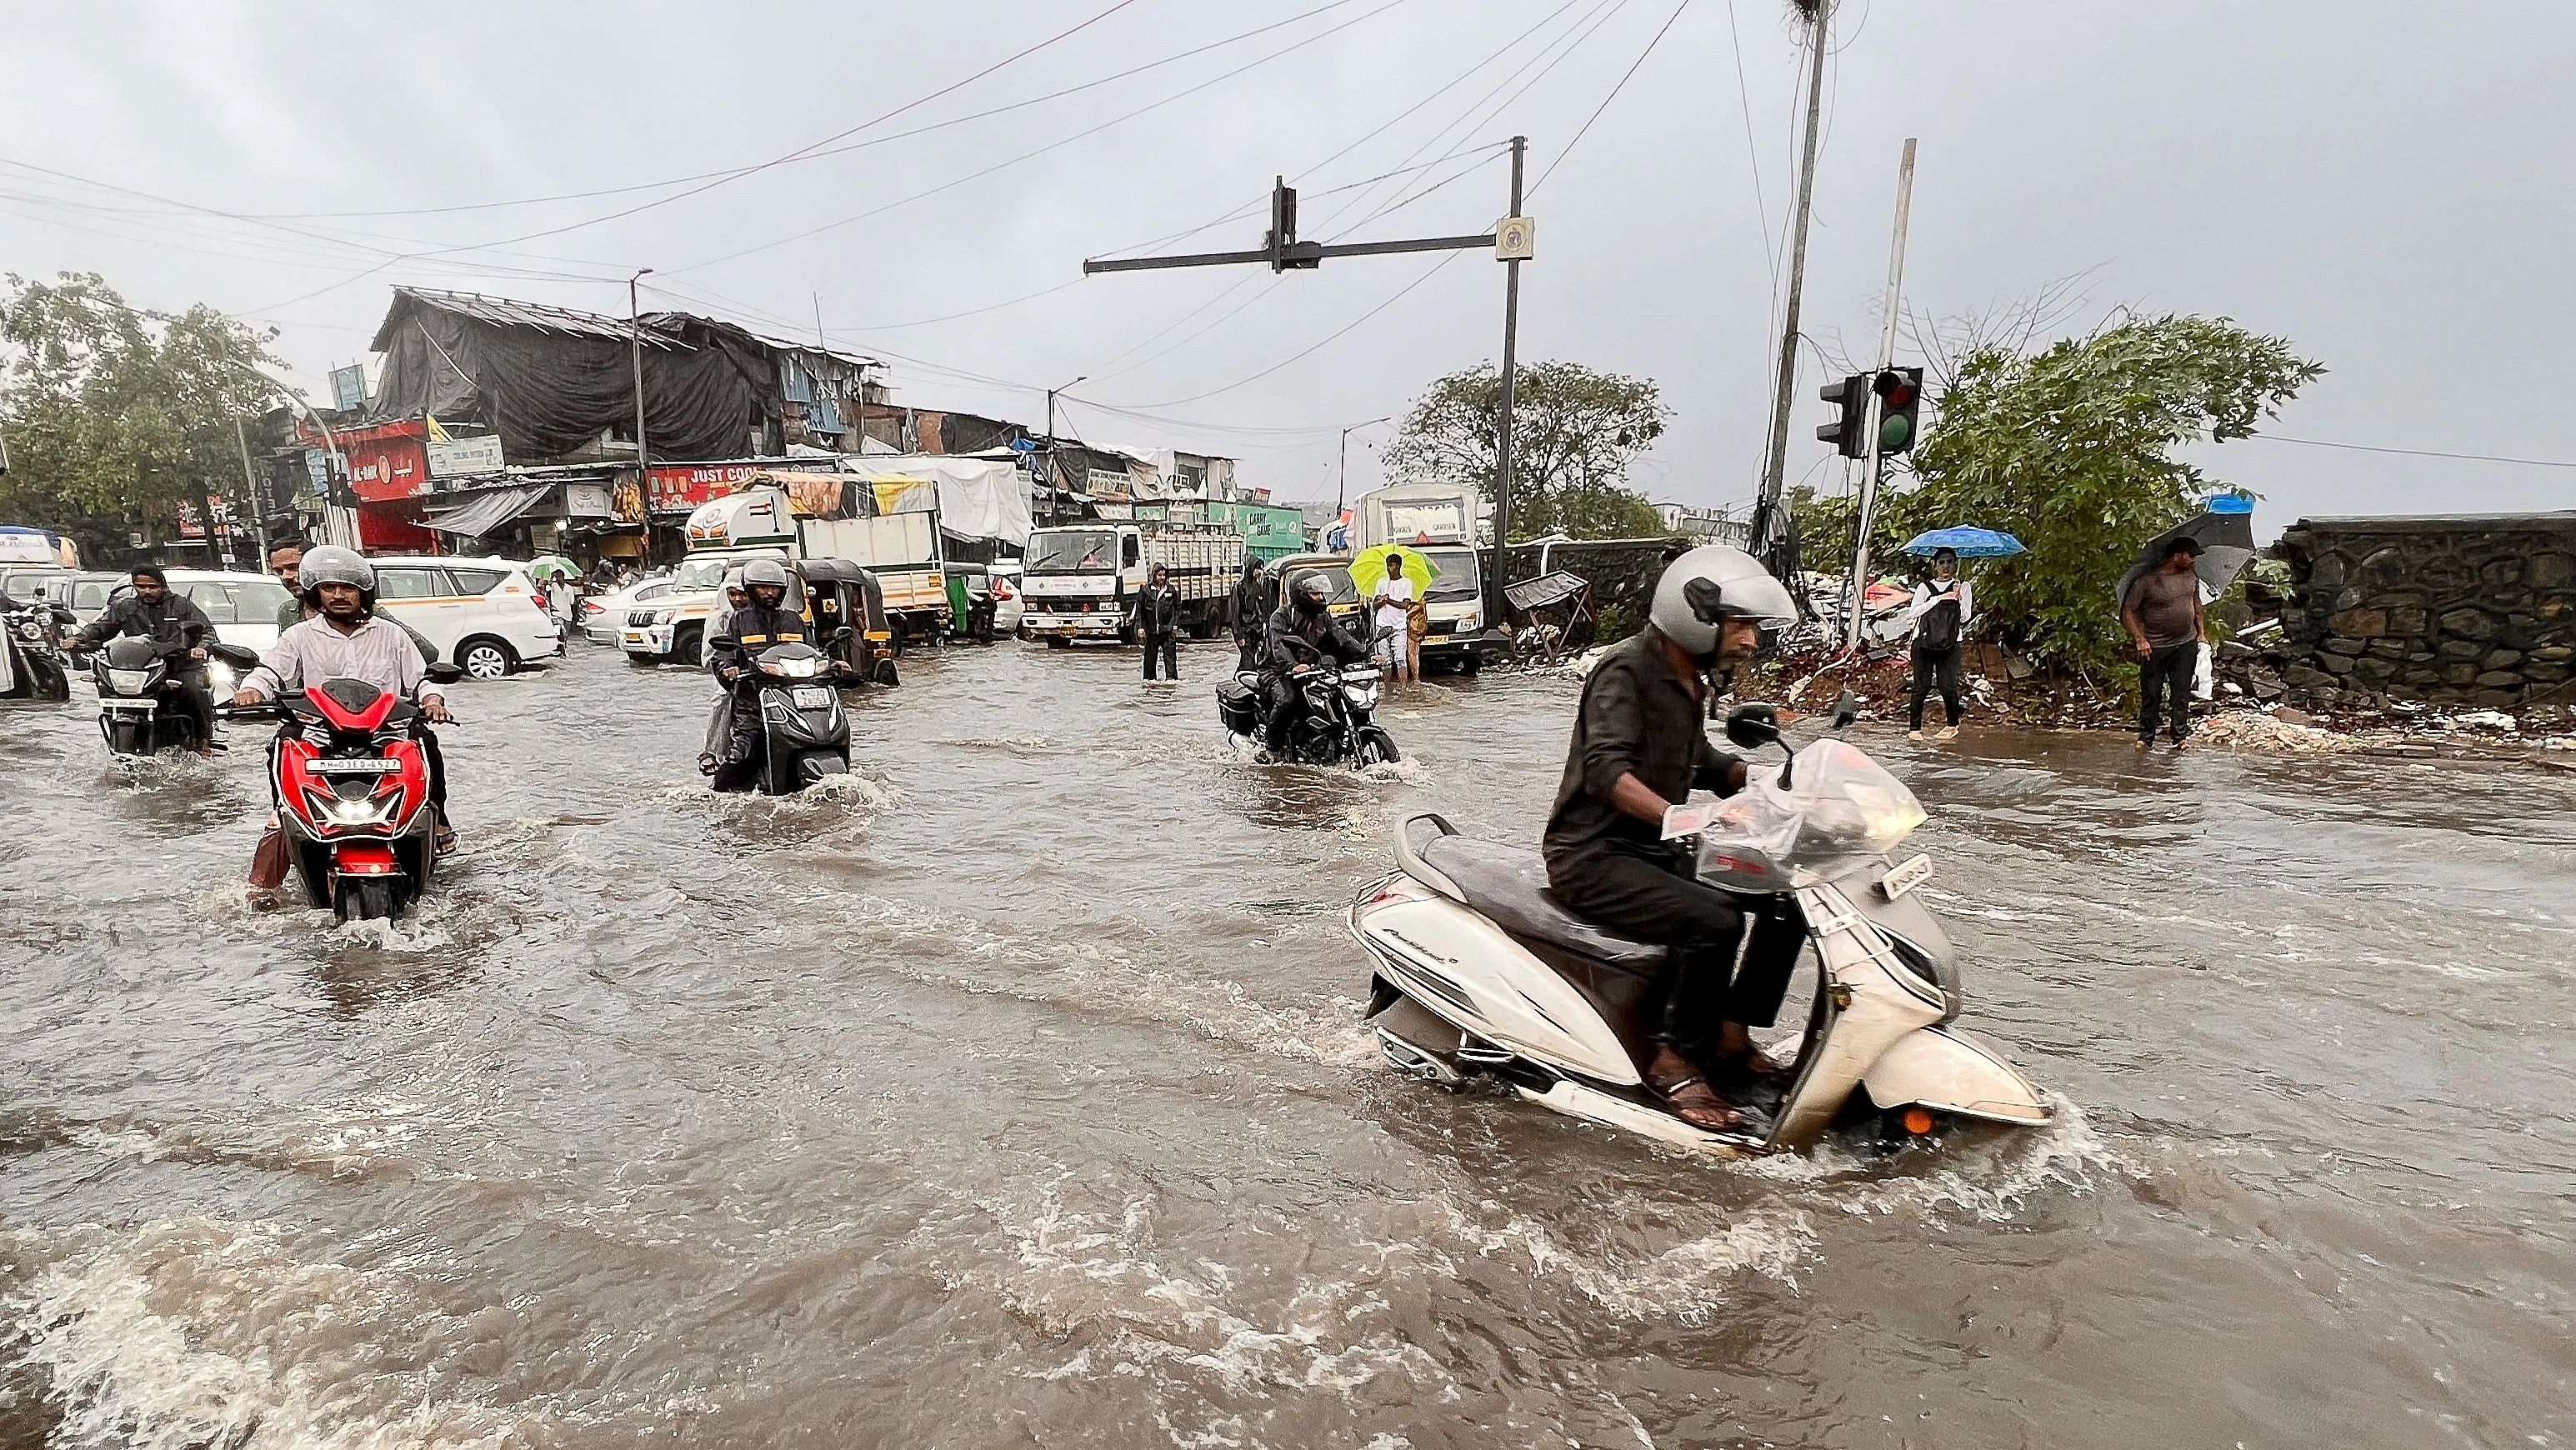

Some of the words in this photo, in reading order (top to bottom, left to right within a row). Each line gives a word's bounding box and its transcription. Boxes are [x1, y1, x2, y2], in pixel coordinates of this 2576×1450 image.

[691, 469, 723, 483] JUST
[1250, 512, 1267, 526] CARRY
[1257, 524, 1272, 537] GAME
